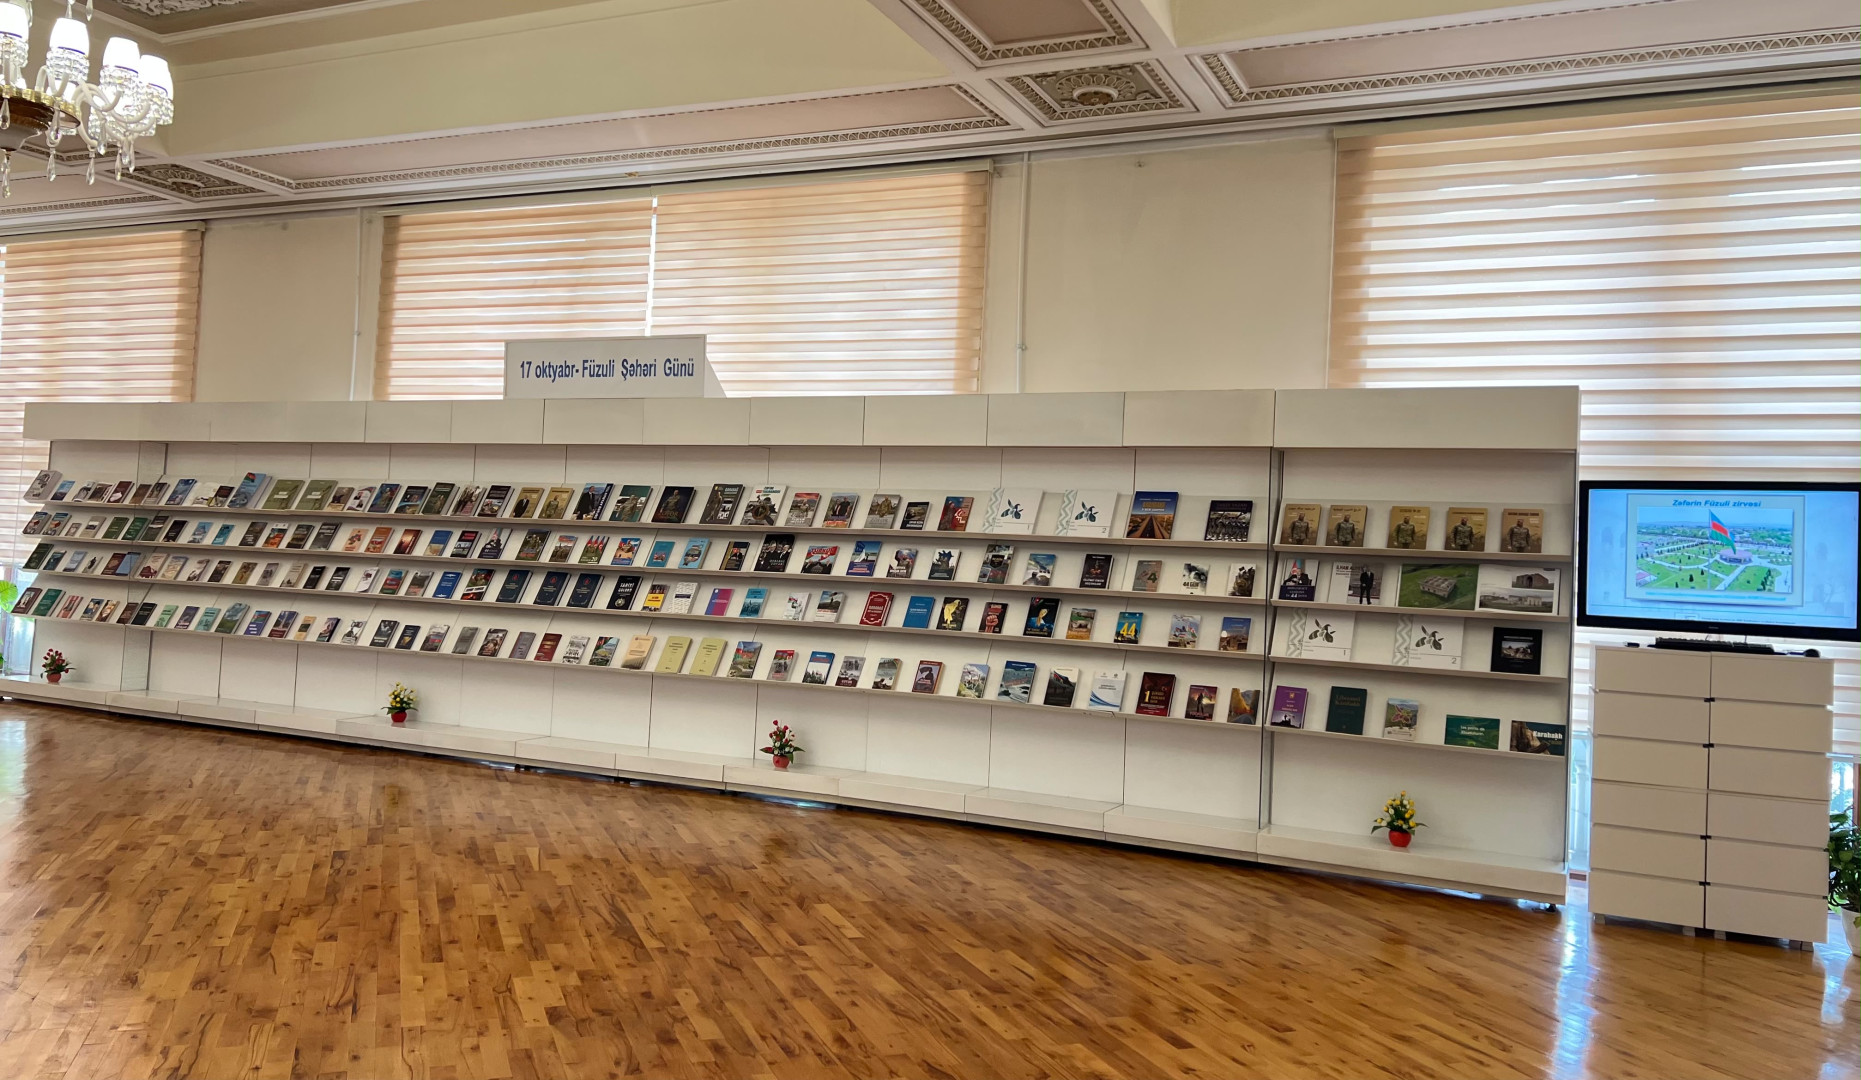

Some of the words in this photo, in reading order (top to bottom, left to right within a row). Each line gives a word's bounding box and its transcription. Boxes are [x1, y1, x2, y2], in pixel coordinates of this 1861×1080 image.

[520, 360, 532, 378] 17
[535, 360, 579, 383] oktyabr-
[582, 359, 615, 378] Füzuli
[621, 358, 657, 381] Şəhəri
[663, 358, 694, 377] Günü
[1703, 499, 1731, 507] Füzuli
[1120, 622, 1136, 636] 44
